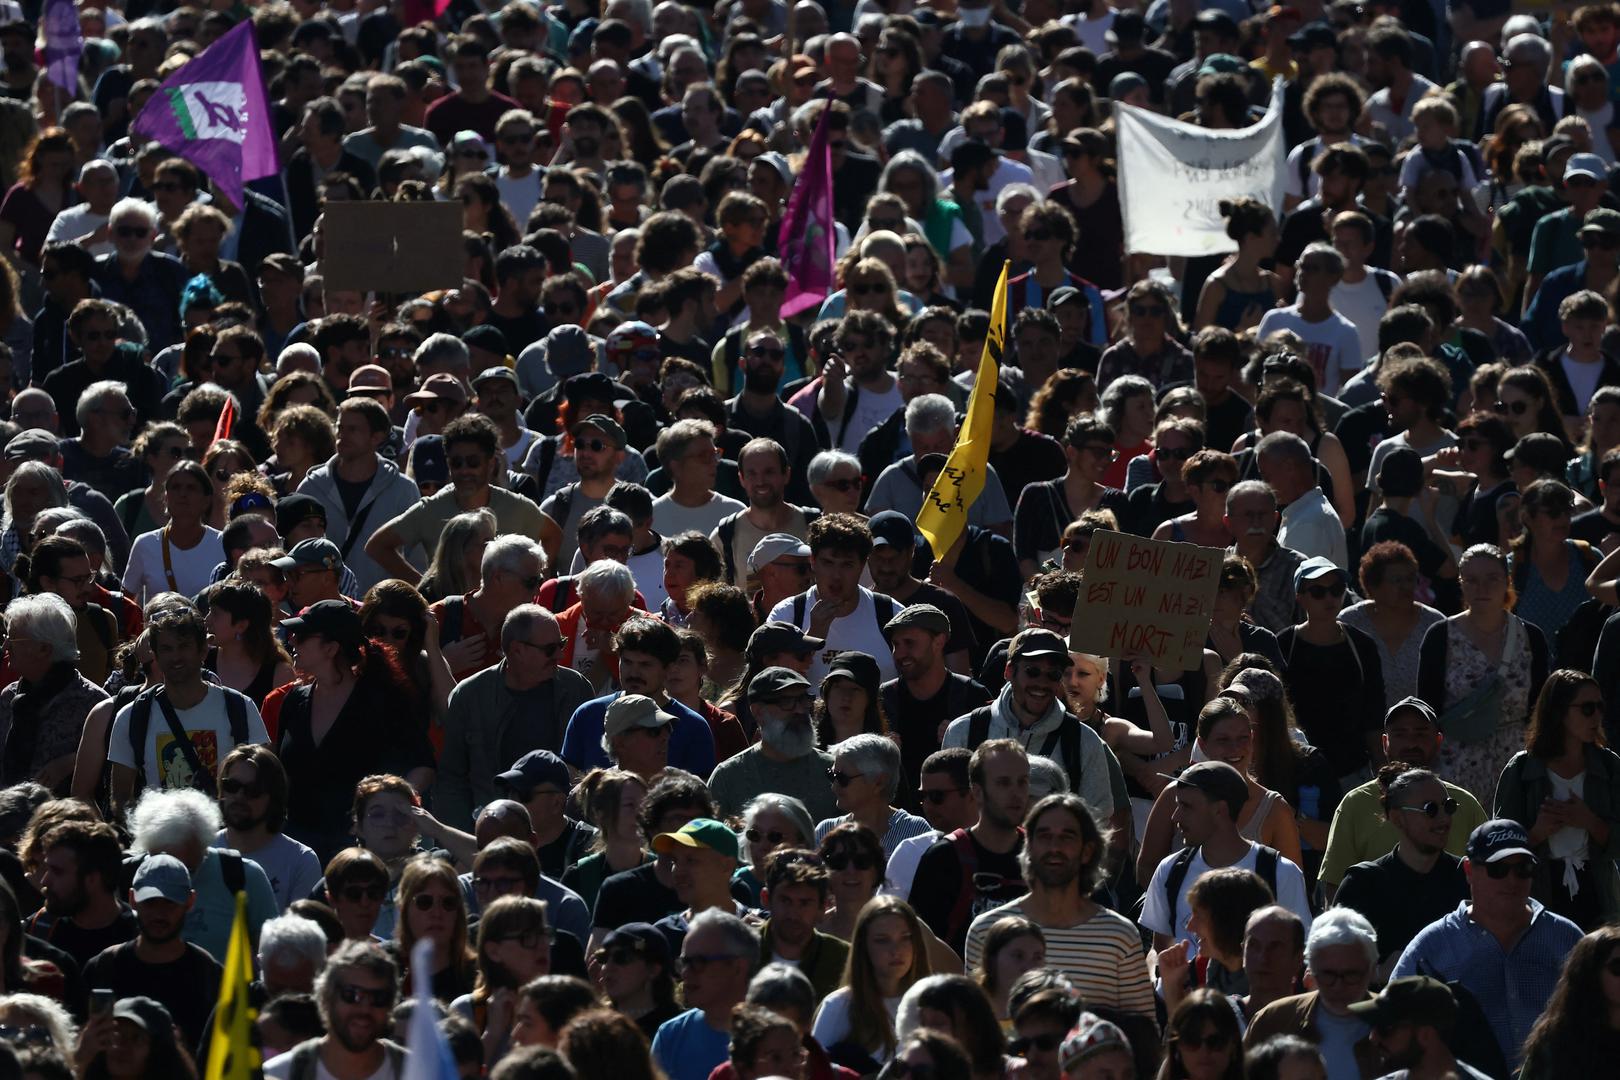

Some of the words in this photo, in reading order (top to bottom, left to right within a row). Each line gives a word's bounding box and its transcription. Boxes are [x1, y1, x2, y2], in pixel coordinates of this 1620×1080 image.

[1096, 540, 1122, 569] UN
[1127, 543, 1165, 576] BON
[1087, 582, 1117, 605] EST
[1124, 587, 1146, 607] UN
